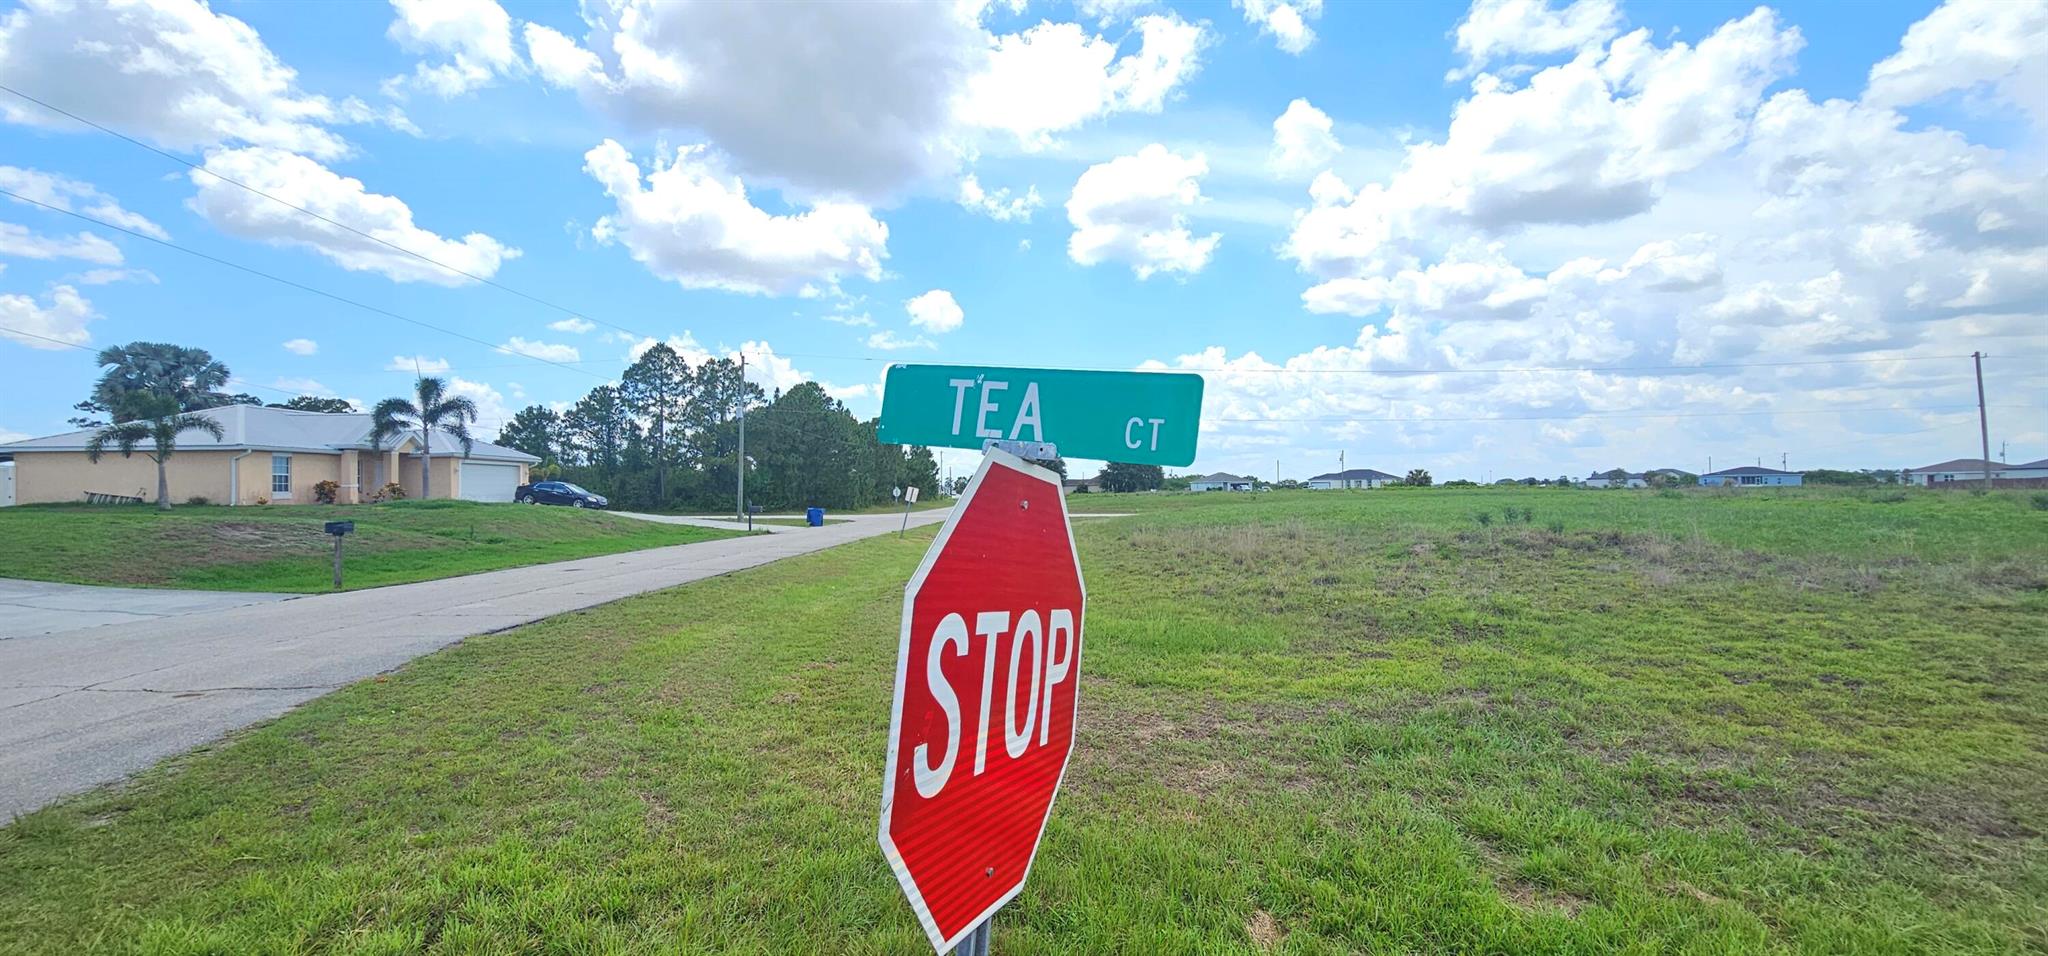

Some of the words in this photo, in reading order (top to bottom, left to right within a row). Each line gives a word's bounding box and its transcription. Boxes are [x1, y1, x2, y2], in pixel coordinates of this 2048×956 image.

[949, 379, 1044, 441] TEA
[1124, 417, 1165, 451] CT
[914, 609, 1074, 798] STOP
